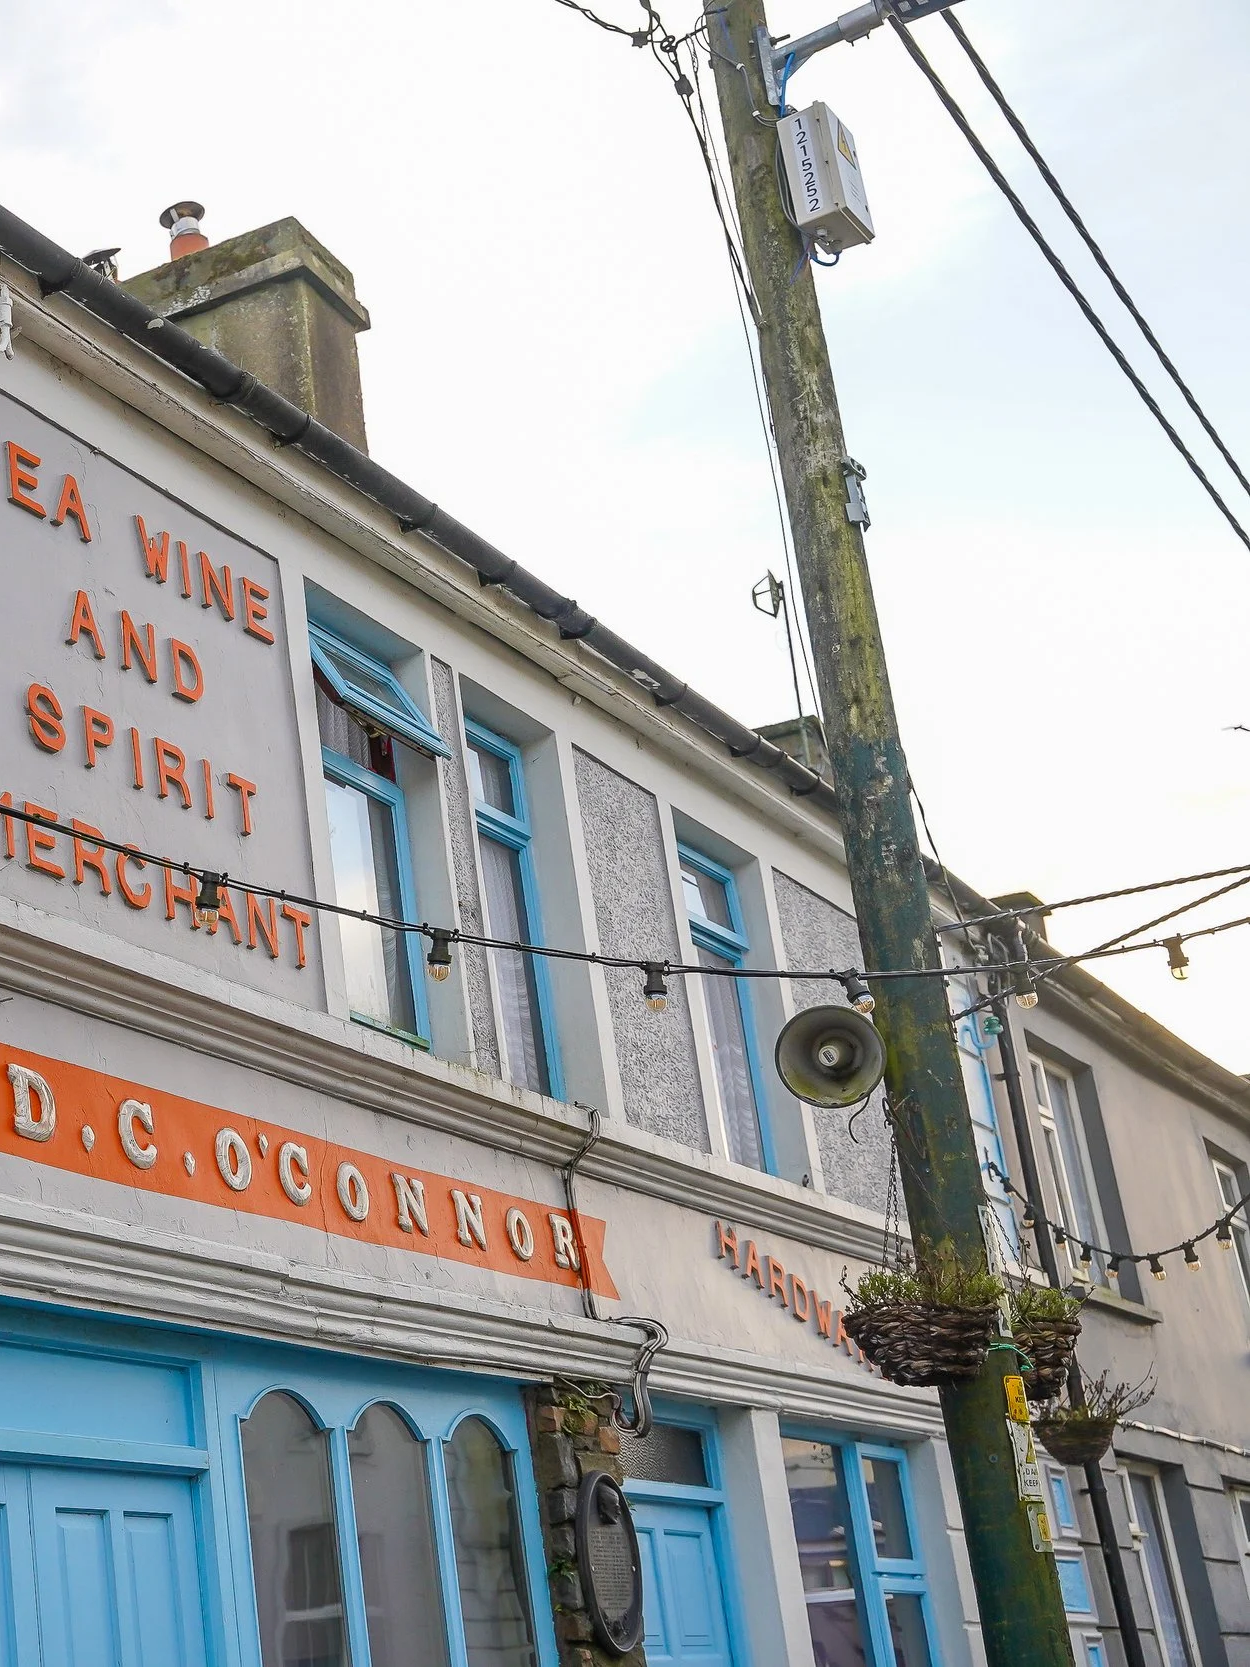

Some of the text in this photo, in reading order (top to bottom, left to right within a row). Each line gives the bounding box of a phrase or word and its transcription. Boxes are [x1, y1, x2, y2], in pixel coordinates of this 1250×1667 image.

[794, 117, 821, 213] 1215252
[133, 514, 275, 646] WINE
[65, 589, 205, 704] AND
[25, 682, 257, 837] SPIRIT
